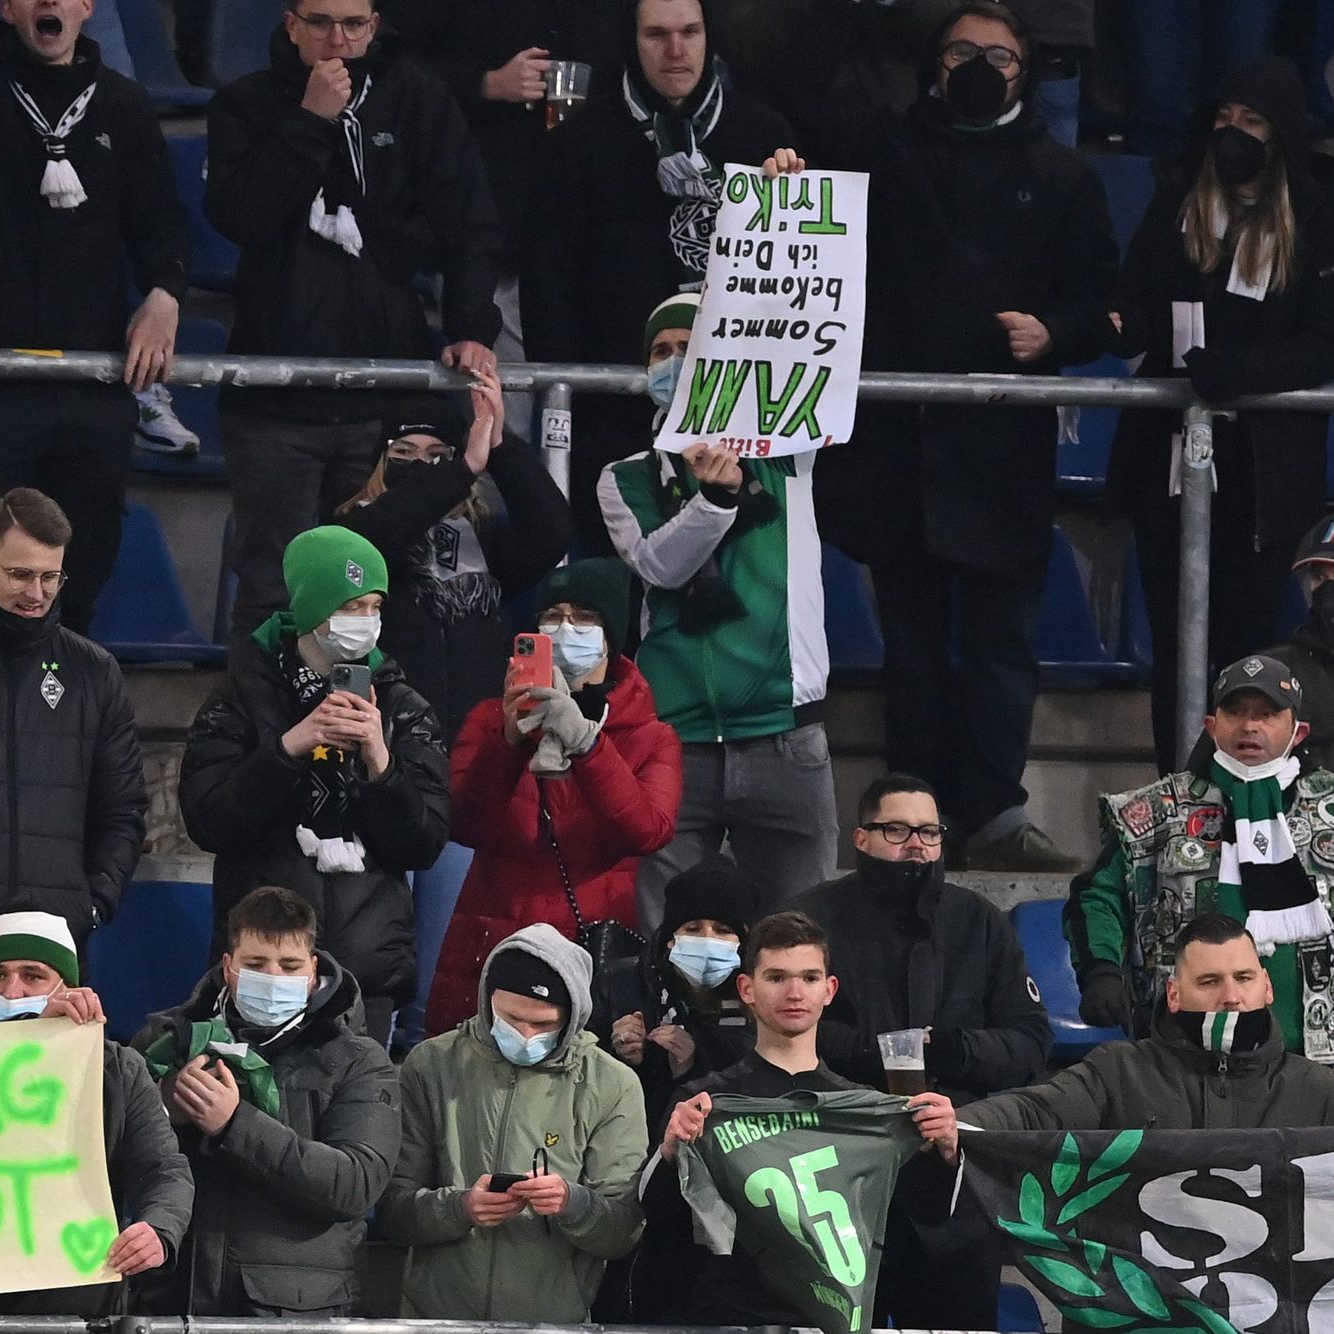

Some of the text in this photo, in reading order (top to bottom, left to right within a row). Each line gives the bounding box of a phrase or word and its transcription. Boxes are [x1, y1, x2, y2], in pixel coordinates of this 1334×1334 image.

[716, 237, 817, 270] ich Dein
[677, 358, 832, 438] YANN
[744, 1145, 867, 1287] 25
